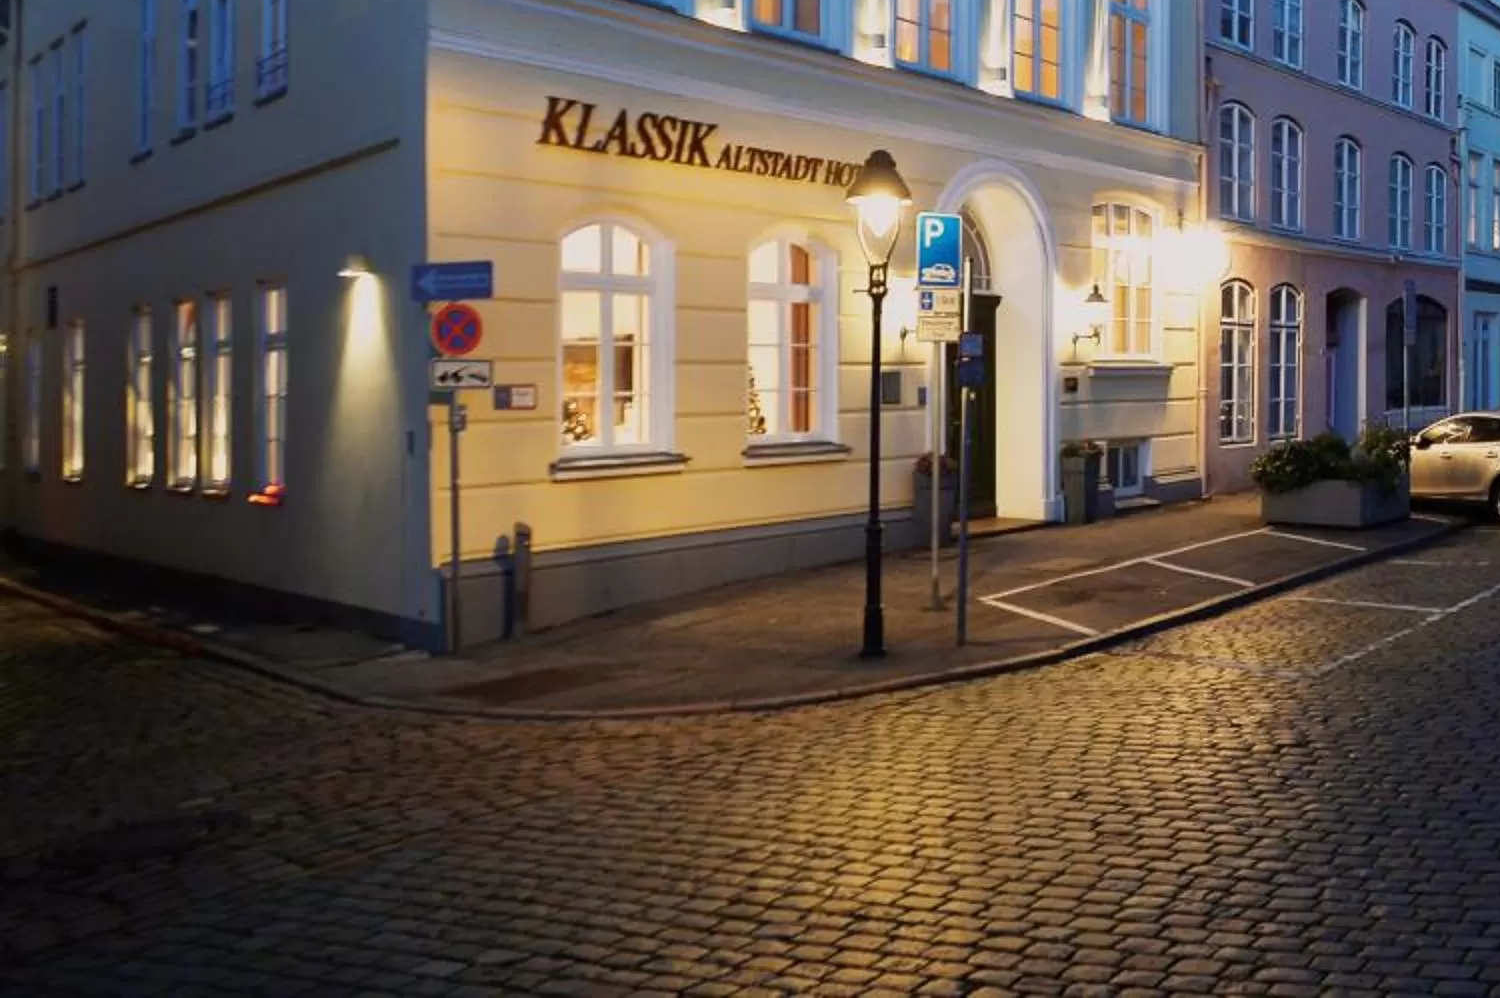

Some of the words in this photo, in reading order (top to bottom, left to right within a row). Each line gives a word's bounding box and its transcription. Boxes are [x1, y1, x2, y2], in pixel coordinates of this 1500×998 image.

[536, 96, 719, 168] KLASSIK
[715, 143, 824, 183] ALTSTADT
[824, 159, 864, 187] HOT
[924, 218, 945, 248] P
